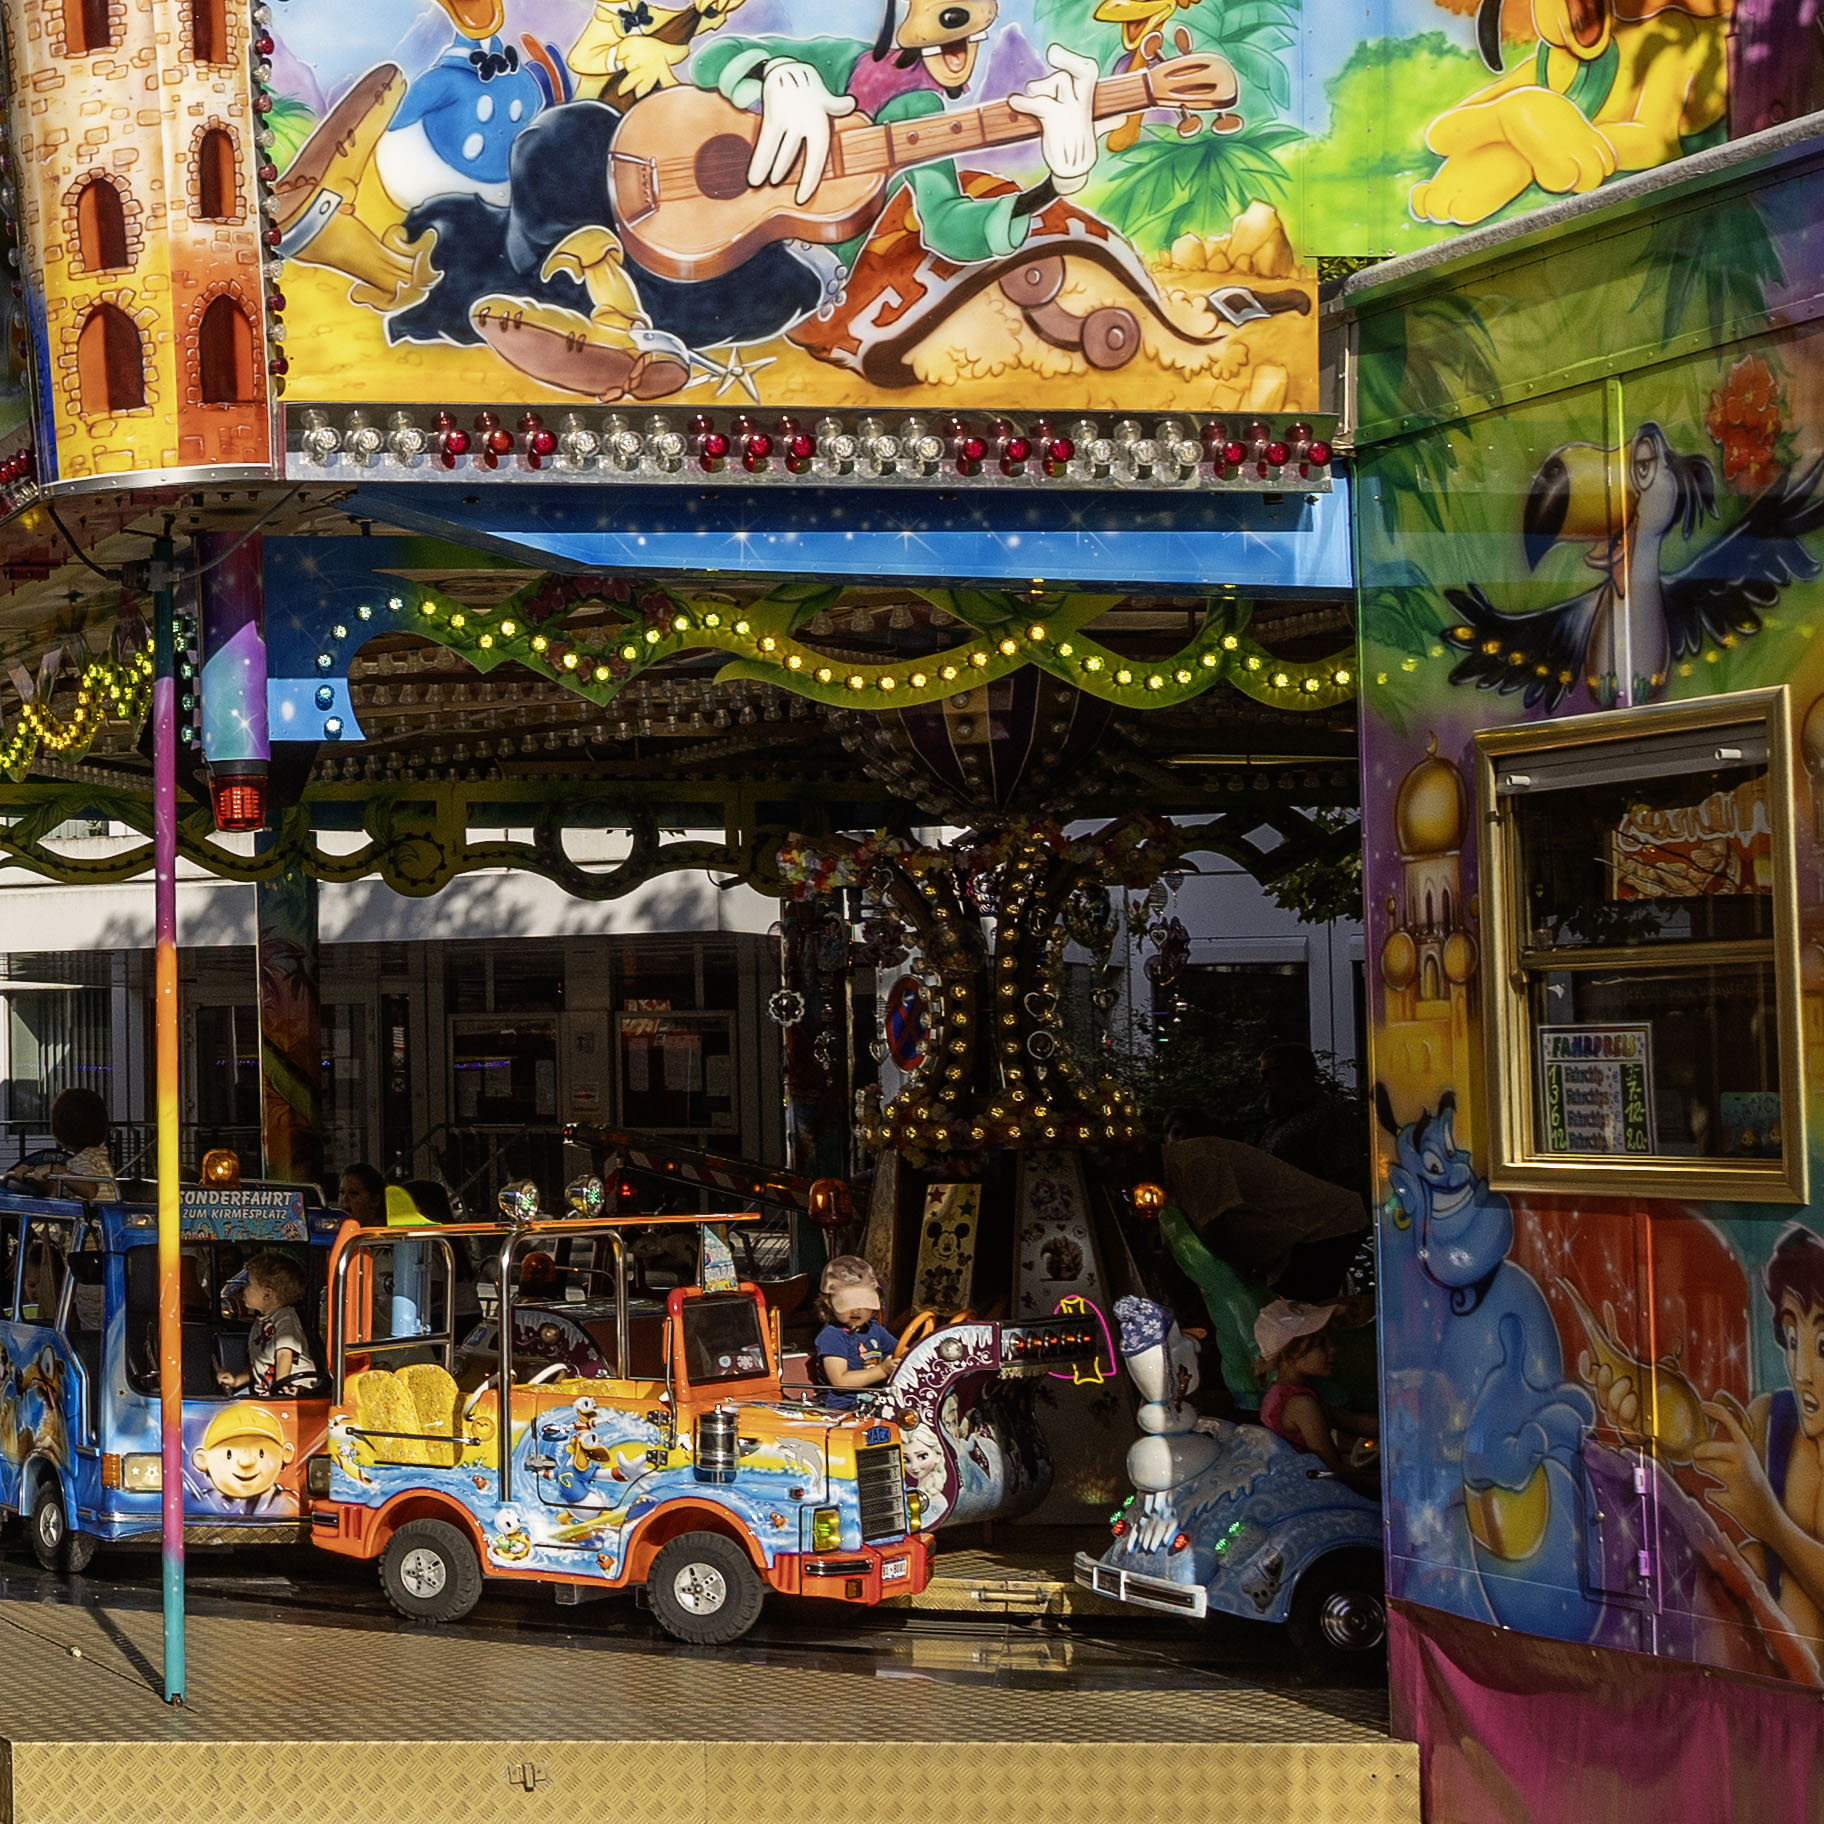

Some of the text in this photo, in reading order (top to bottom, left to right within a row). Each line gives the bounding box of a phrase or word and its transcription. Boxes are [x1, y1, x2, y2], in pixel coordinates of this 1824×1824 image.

[1552, 1035, 1637, 1058] FAHRPREIS
[183, 1209, 289, 1221] ZUM KIRMESPLATZ
